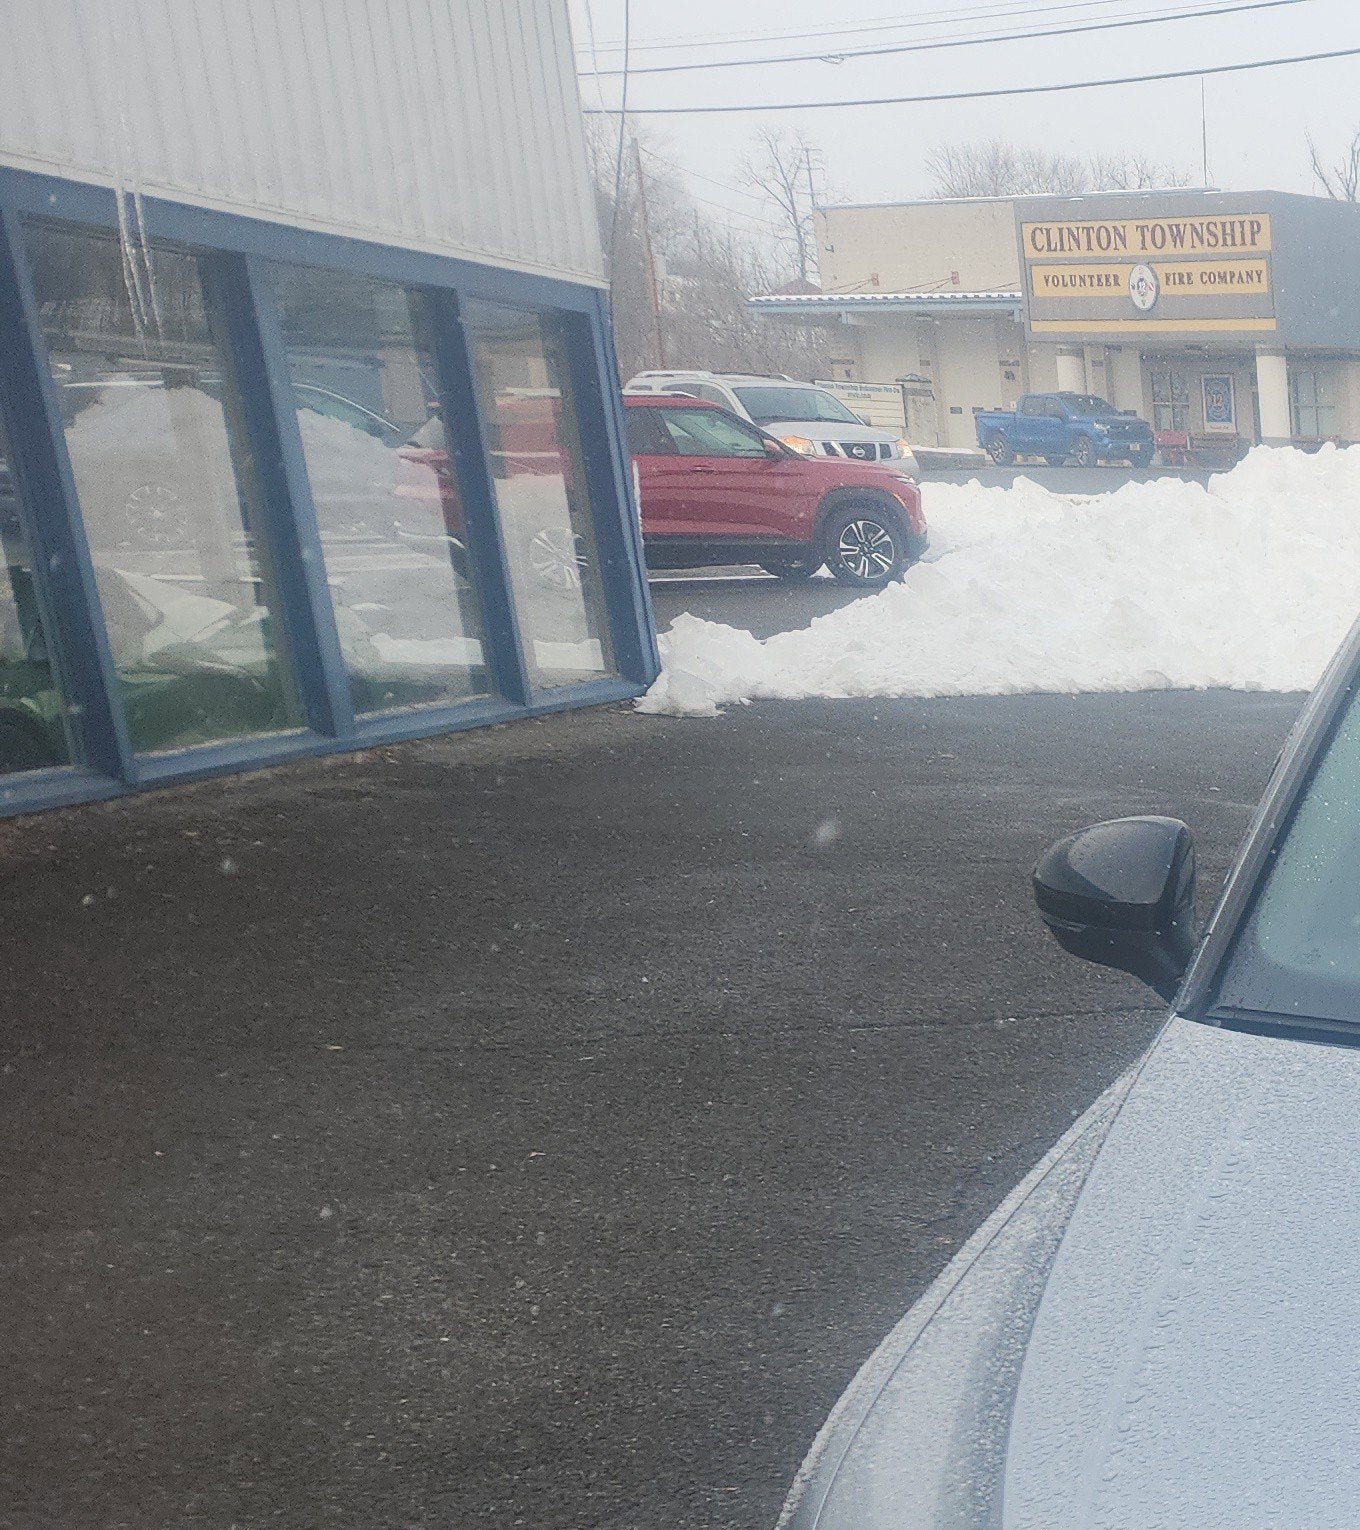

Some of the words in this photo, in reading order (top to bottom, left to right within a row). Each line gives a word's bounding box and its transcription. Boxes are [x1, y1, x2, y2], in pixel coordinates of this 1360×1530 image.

[1030, 225, 1128, 253] CLINTON
[1136, 219, 1262, 251] TOWNSHIP
[1043, 274, 1121, 287] VOLUNTEER
[1164, 271, 1194, 286] FIRE
[1200, 269, 1263, 285] COMPANY
